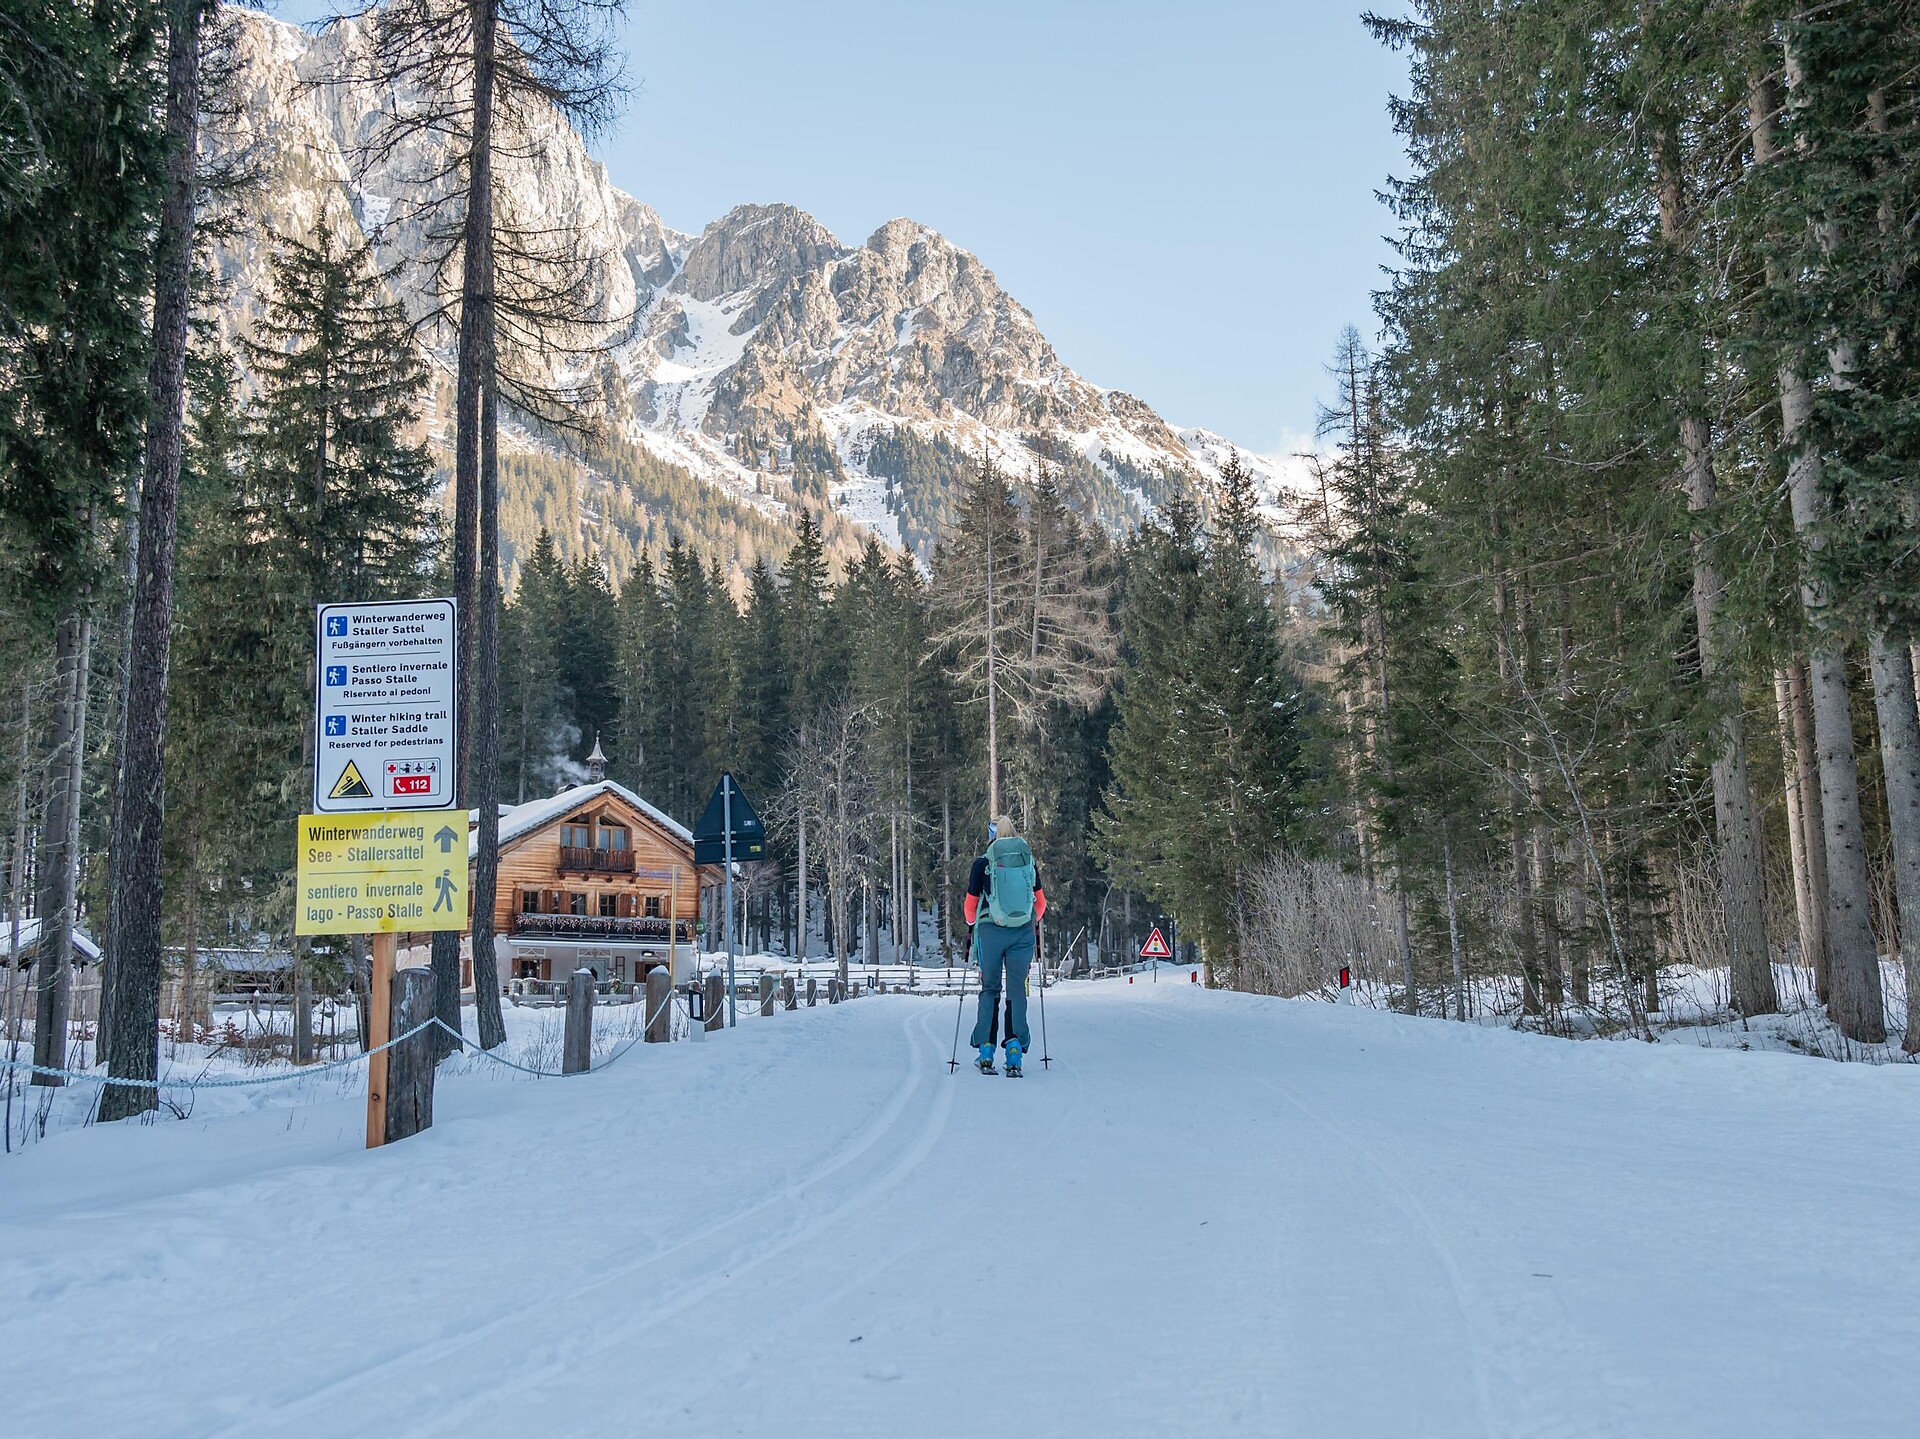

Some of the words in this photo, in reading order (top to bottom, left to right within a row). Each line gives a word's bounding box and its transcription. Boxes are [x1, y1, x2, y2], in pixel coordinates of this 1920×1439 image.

[352, 612, 445, 623] Winterwanderweg
[353, 626, 388, 635] Staller
[393, 625, 425, 634] Sattel
[332, 640, 386, 650] Fußgängern
[389, 637, 442, 647] vorbehalten
[352, 664, 396, 673] Sentiero
[400, 661, 448, 671] invernale
[352, 676, 382, 685] Passo
[386, 675, 417, 684] Stalle
[344, 689, 387, 698] Riservato
[401, 687, 430, 696] pedoni
[352, 714, 386, 722] Winter
[390, 712, 421, 722] hiking
[425, 711, 447, 720] trail
[352, 727, 388, 735] Staller
[392, 724, 428, 733] Saddle
[329, 740, 371, 749] Reserved
[391, 738, 443, 747] pedestrians
[410, 780, 427, 790] 112
[309, 826, 424, 841] Winterwanderweg
[309, 848, 332, 862] See
[348, 846, 423, 862] Stallersattel
[308, 884, 357, 899] sentiero
[366, 882, 422, 897] invernale
[347, 905, 383, 919] Passo
[388, 904, 422, 918] Stalle
